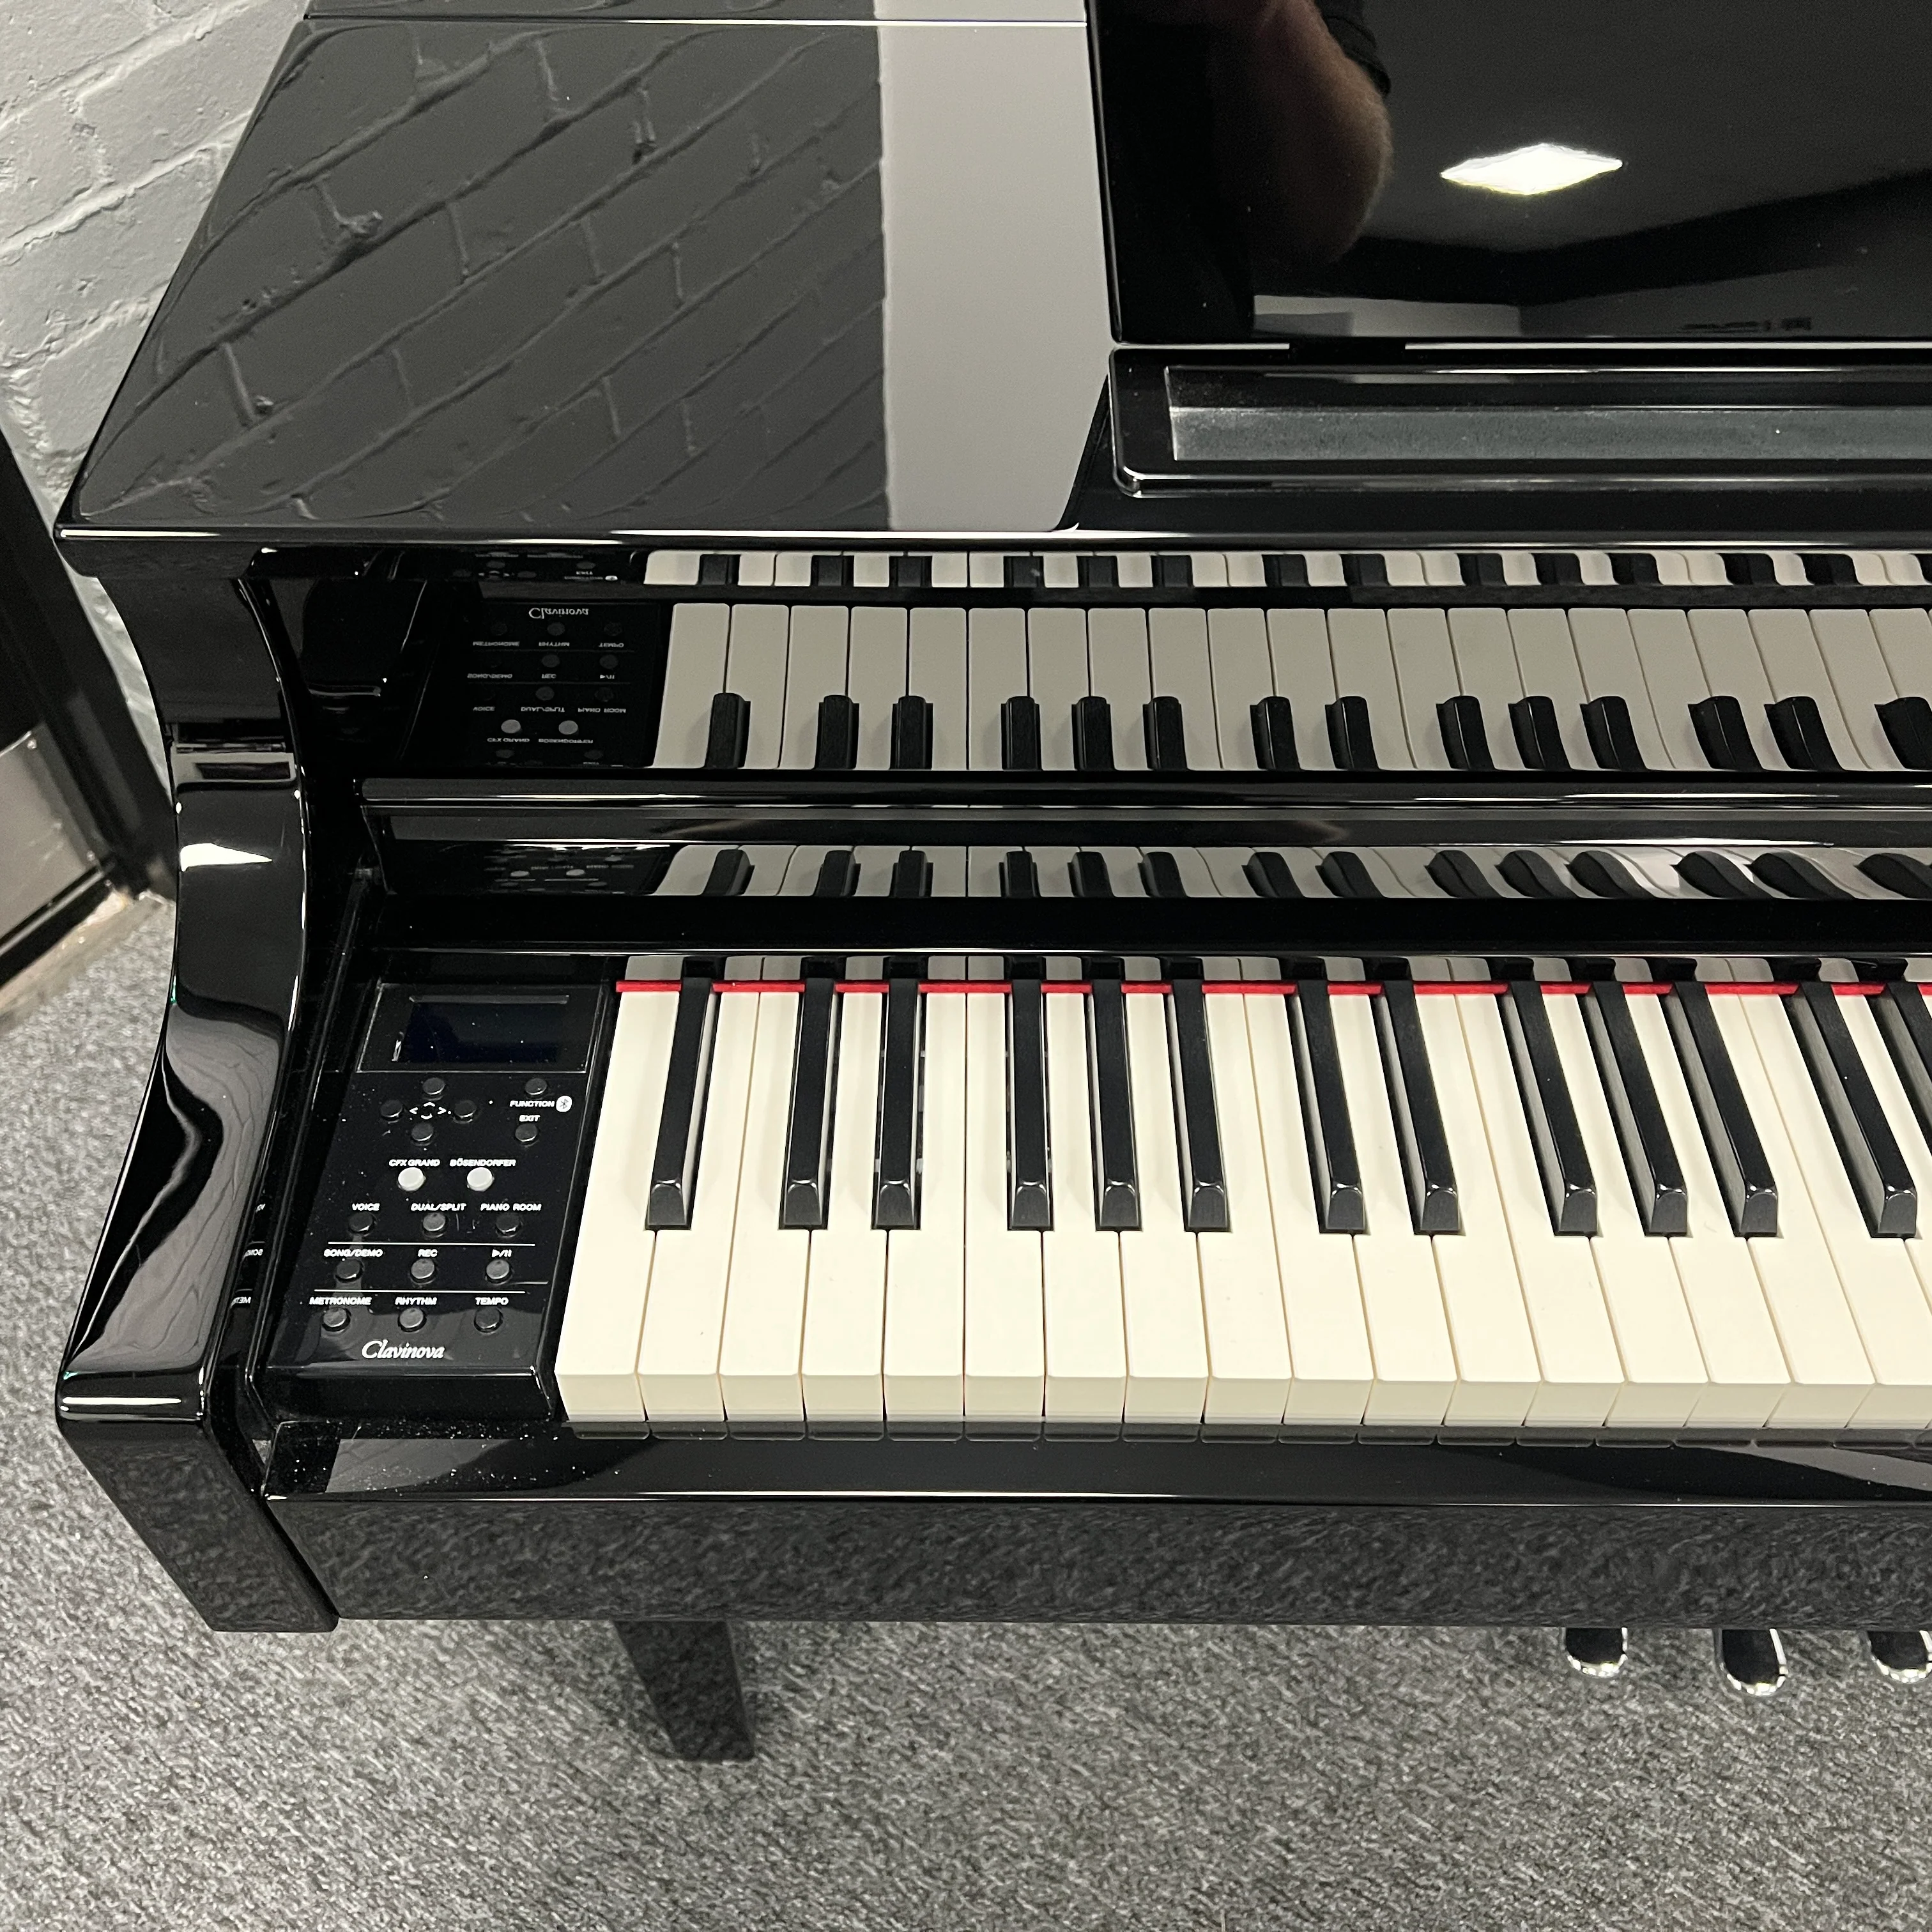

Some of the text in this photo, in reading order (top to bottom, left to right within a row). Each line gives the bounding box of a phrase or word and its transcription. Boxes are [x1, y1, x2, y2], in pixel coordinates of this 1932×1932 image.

[509, 1100, 555, 1108] FUNCTION
[519, 1114, 541, 1123] EXIT
[388, 1158, 441, 1167] CFX GRAND
[351, 1202, 380, 1211] VOICE
[410, 1202, 467, 1211] DUAL/SPLIT
[480, 1202, 542, 1211] PIANO ROOM
[323, 1248, 383, 1257] SONG/DEMO
[417, 1248, 438, 1257] REC
[309, 1295, 372, 1305] METRONOME
[394, 1296, 438, 1305] RHYTHM
[475, 1296, 509, 1305] TEMPO
[361, 1338, 445, 1359] Clavinova
